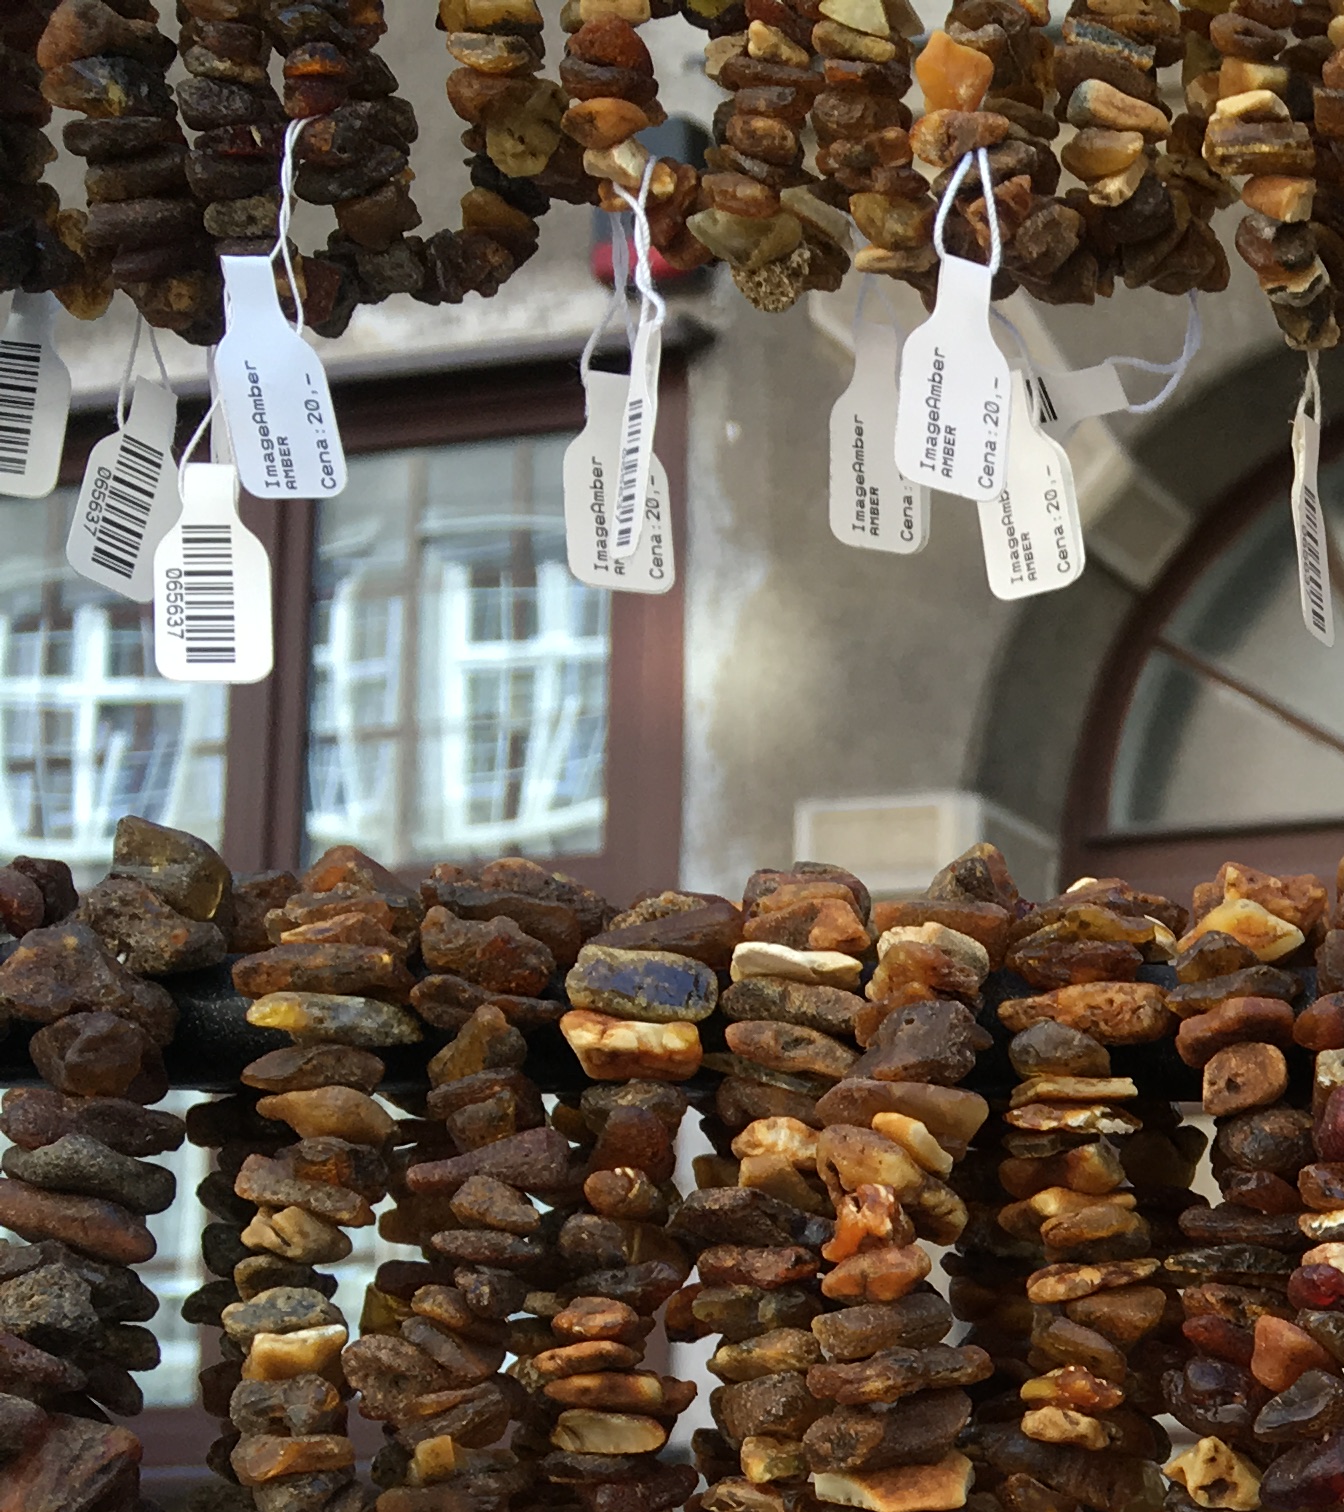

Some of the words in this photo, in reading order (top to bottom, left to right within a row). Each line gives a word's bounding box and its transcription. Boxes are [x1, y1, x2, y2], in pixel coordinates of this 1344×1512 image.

[244, 360, 280, 489] ImageAmber
[921, 347, 947, 471] ImageAmber
[278, 435, 298, 490] AMBER
[852, 415, 865, 534] ImageAmber
[942, 425, 957, 478] AMBER
[78, 466, 112, 536] 065637
[592, 456, 609, 571] ImageAmber
[870, 487, 880, 536] AMBER
[1000, 486, 1024, 584] ImageAmb
[1020, 531, 1038, 581] AMBER
[166, 568, 185, 639] 065637
